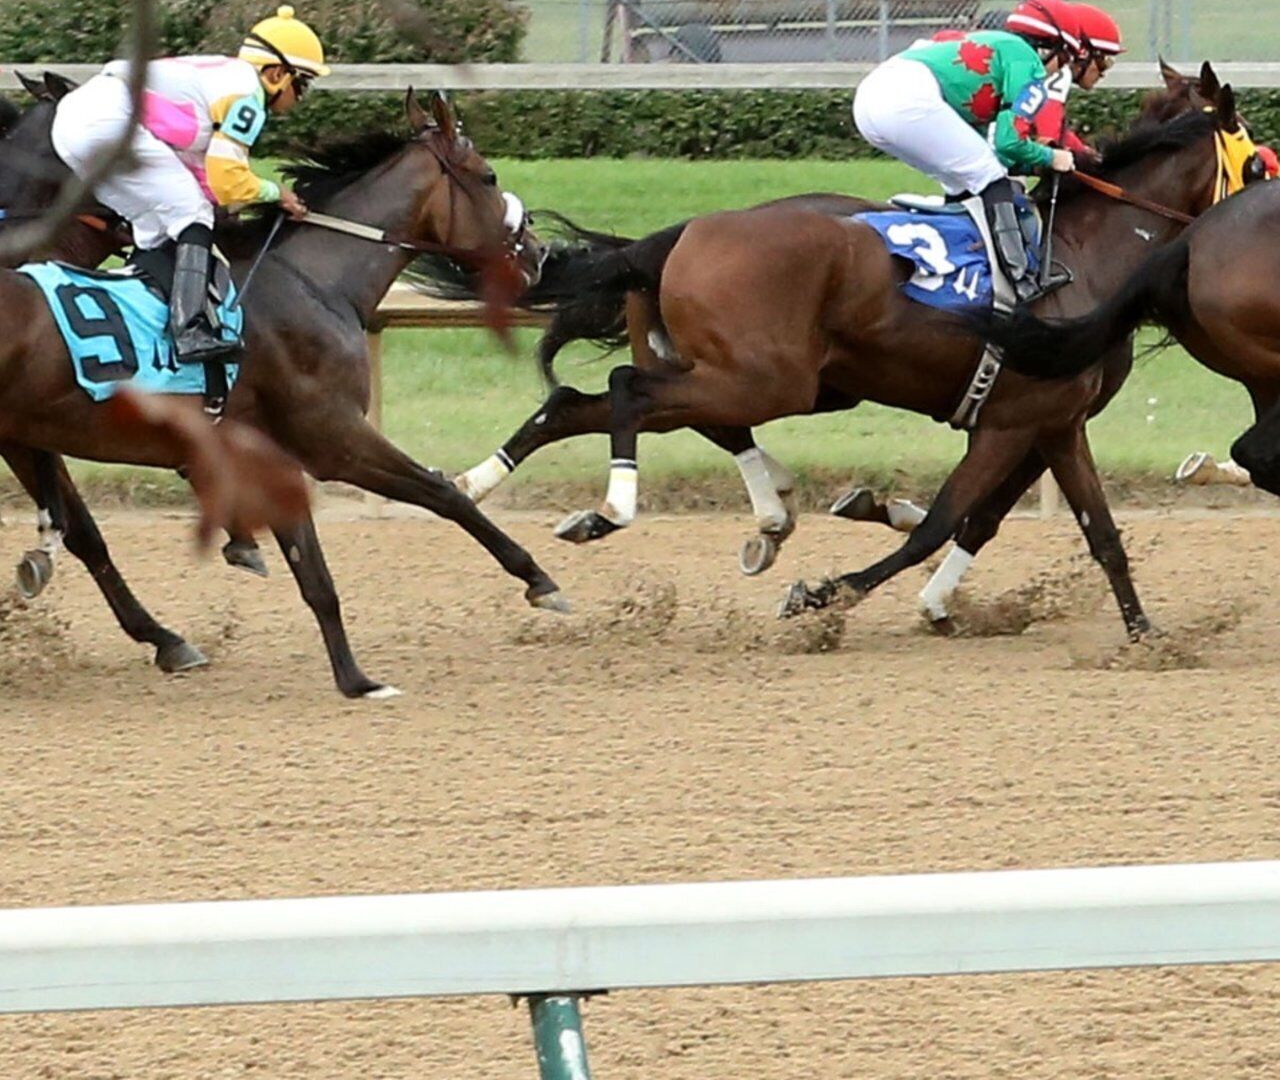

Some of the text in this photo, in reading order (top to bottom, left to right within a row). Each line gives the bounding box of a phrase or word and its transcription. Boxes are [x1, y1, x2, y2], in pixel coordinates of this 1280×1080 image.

[1047, 70, 1064, 94] 2
[1020, 84, 1043, 115] 3
[231, 104, 257, 135] 9
[886, 222, 956, 292] 3
[55, 282, 140, 384] 9
